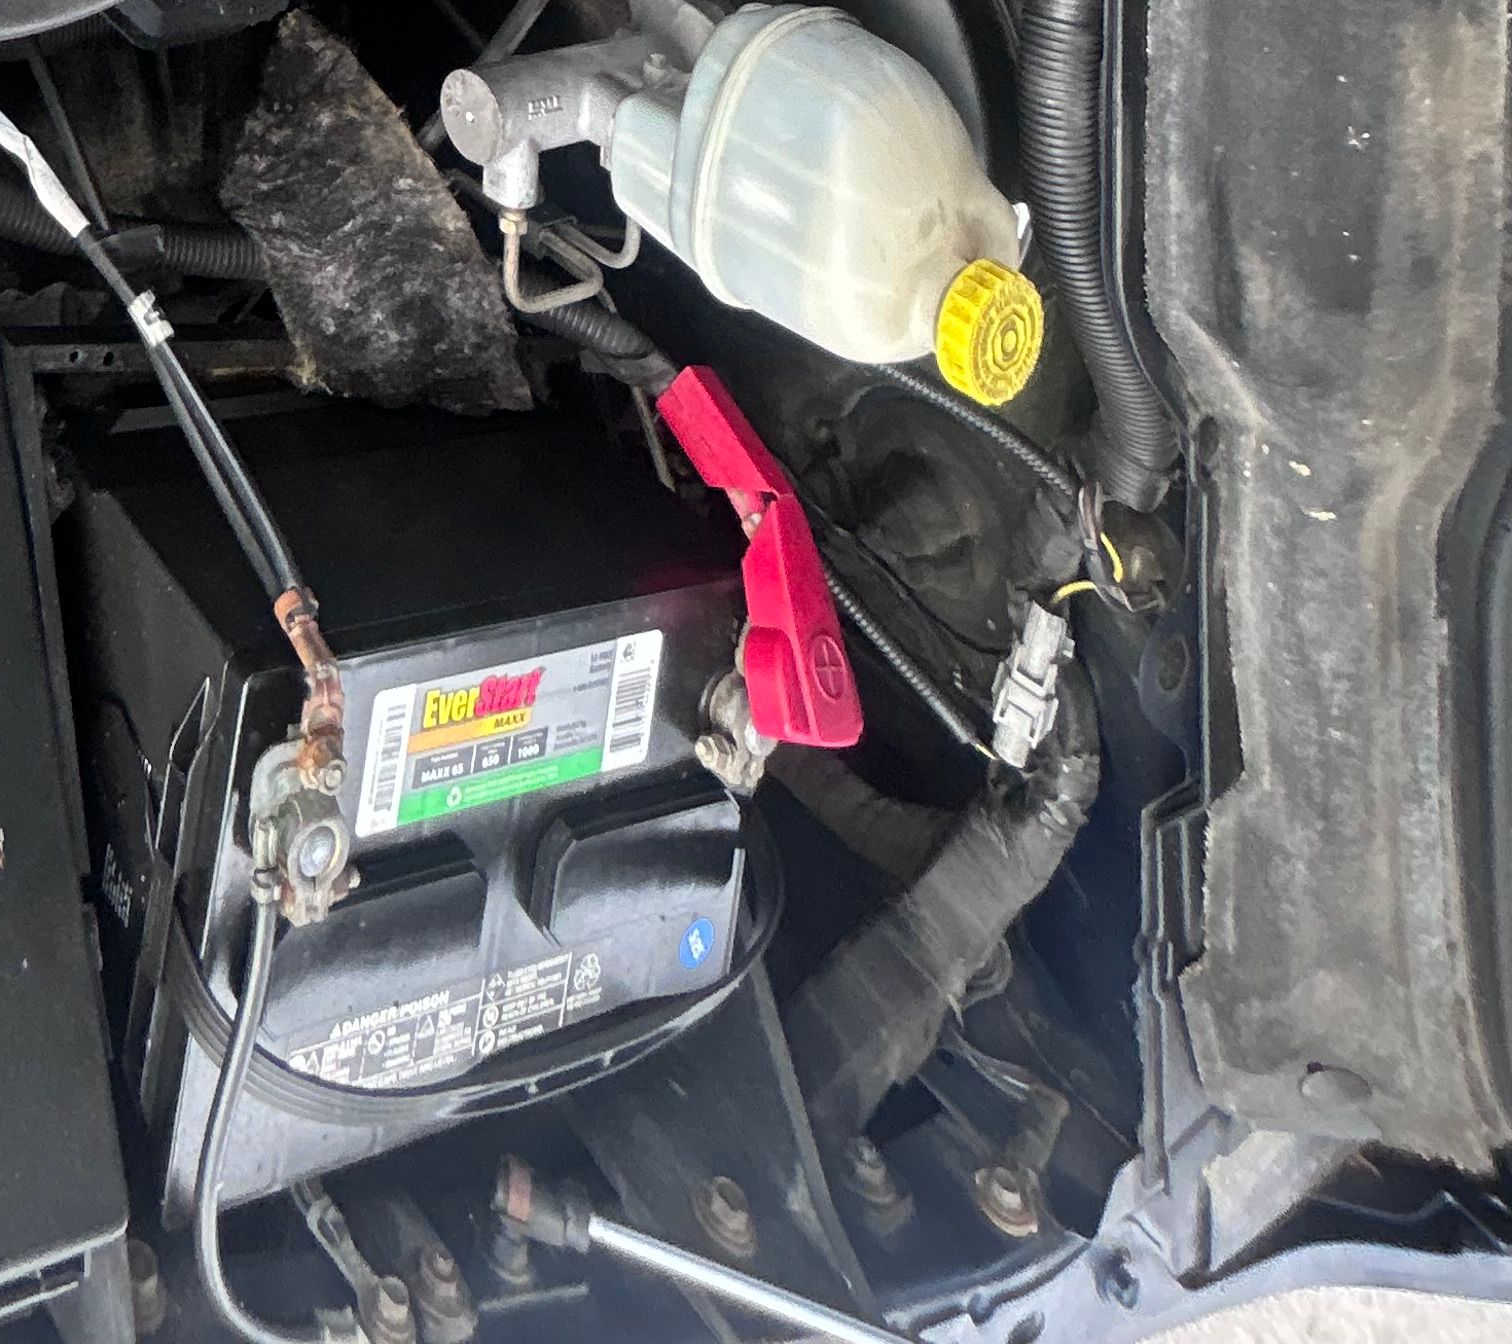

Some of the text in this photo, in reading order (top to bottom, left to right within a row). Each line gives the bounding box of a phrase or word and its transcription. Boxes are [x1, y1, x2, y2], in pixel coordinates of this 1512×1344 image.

[421, 666, 546, 731] EverStart
[493, 710, 529, 731] MAXX
[420, 765, 453, 785] MAXX
